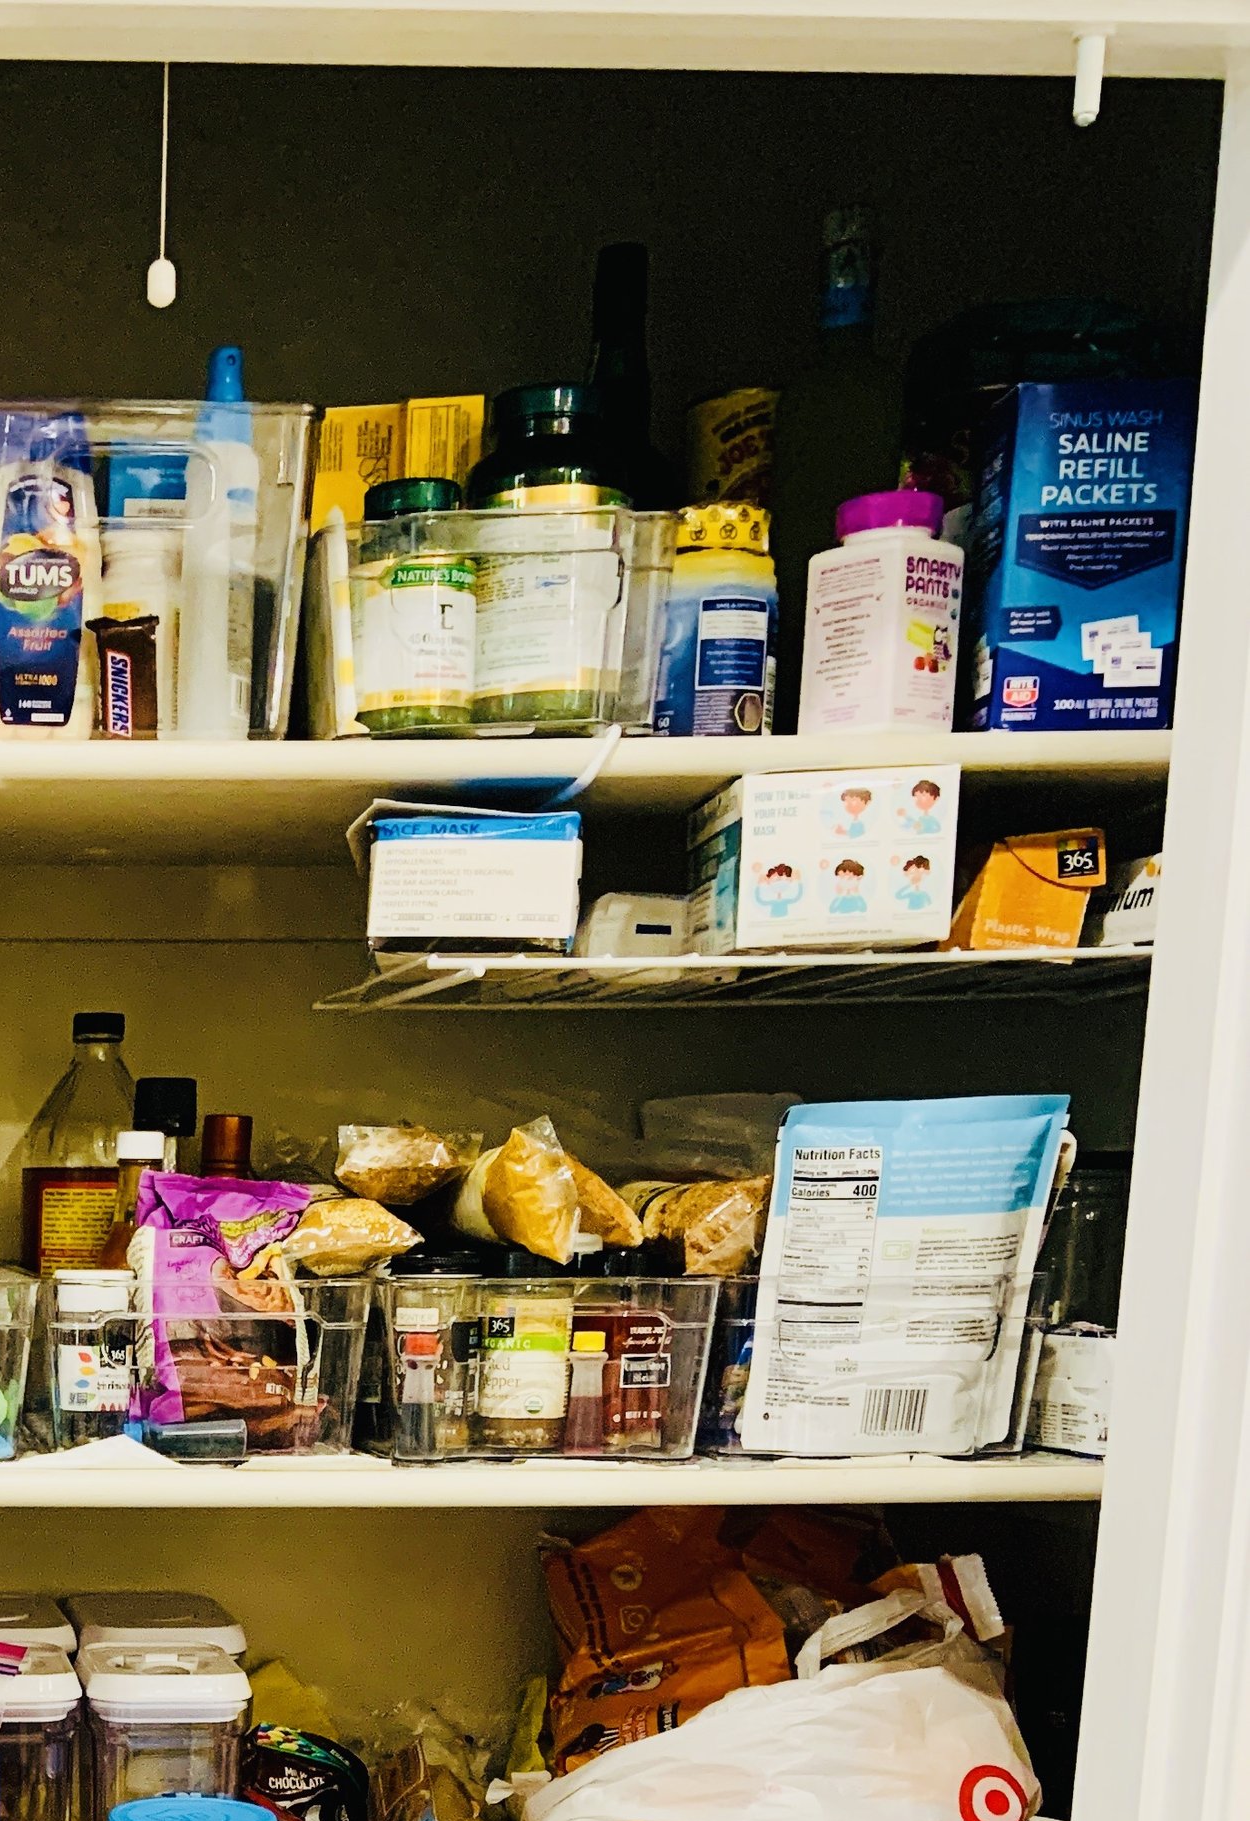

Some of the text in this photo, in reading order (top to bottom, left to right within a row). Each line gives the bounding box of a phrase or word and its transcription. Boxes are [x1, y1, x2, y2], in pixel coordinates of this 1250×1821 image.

[1049, 409, 1163, 428] SINUS WASH
[1058, 432, 1150, 455] SALINE
[1058, 457, 1145, 480] REFILL
[1041, 483, 1158, 507] PACKETS
[1039, 517, 1154, 528] WITH SALINE PACKETS
[5, 564, 73, 588] TUMS
[906, 555, 961, 579] SMARTY
[906, 575, 950, 598] PANTS
[110, 654, 130, 737] SNICKERS
[755, 791, 774, 802] HOW
[776, 791, 786, 801] TO
[754, 807, 798, 819] YOUR FACE
[430, 823, 481, 834] MASK
[753, 826, 777, 836] MASK
[1063, 852, 1095, 872] 365
[984, 918, 1071, 944] Plastic Wrap
[794, 1148, 881, 1162] Nutrition Facts
[791, 1184, 878, 1199] Calories 400
[172, 1235, 205, 1245] CRAFT
[490, 1319, 511, 1334] 365
